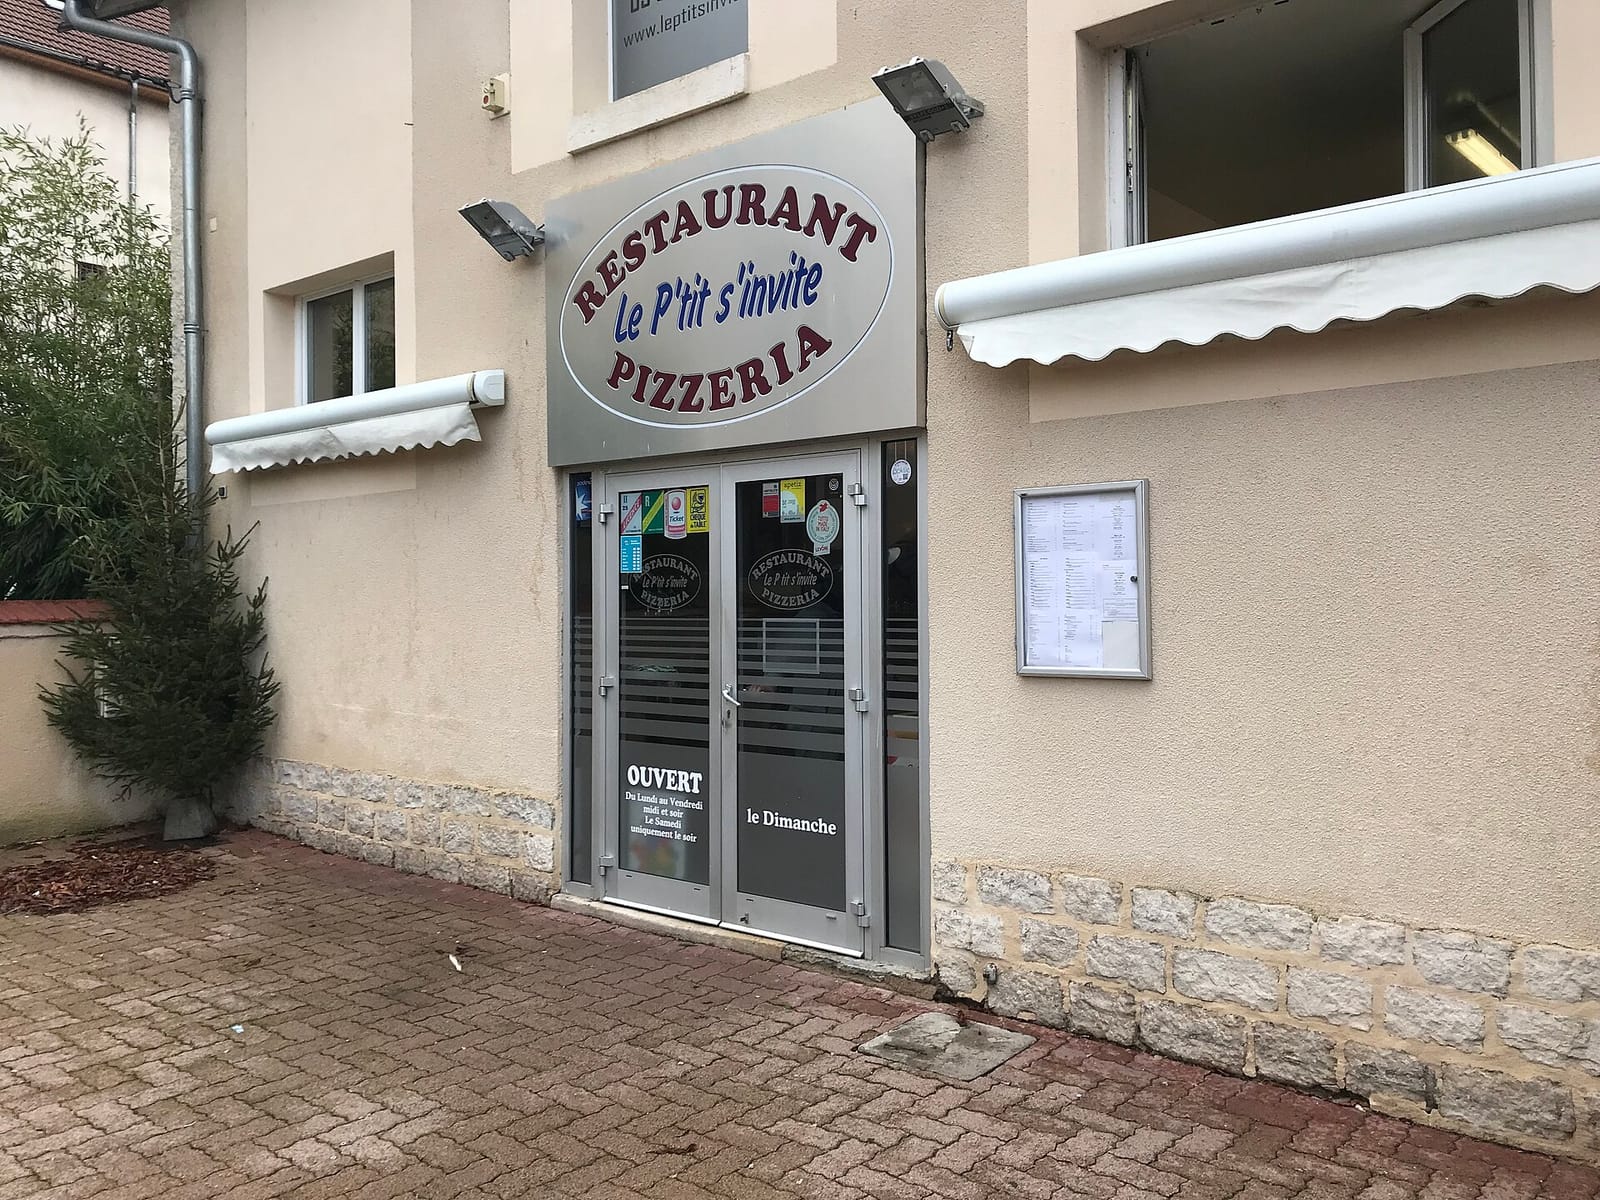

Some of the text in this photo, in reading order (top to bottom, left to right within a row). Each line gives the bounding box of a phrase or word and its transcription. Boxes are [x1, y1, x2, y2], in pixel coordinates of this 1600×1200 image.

[572, 183, 878, 326] RESTAURANT
[613, 250, 823, 344] Le P'tit s'invite
[606, 323, 833, 414] PIZZERIA
[752, 552, 830, 580] RESTAURANT
[764, 573, 772, 586] Le
[761, 588, 820, 607] PIZZERIA
[626, 764, 703, 794] OUVERT
[625, 791, 703, 810] Du Lundi au Vendredi
[643, 805, 684, 818] midi et soir
[645, 815, 682, 829] Le Samedi
[746, 808, 837, 836] le Dimanche
[630, 825, 697, 843] uniquement le soir
